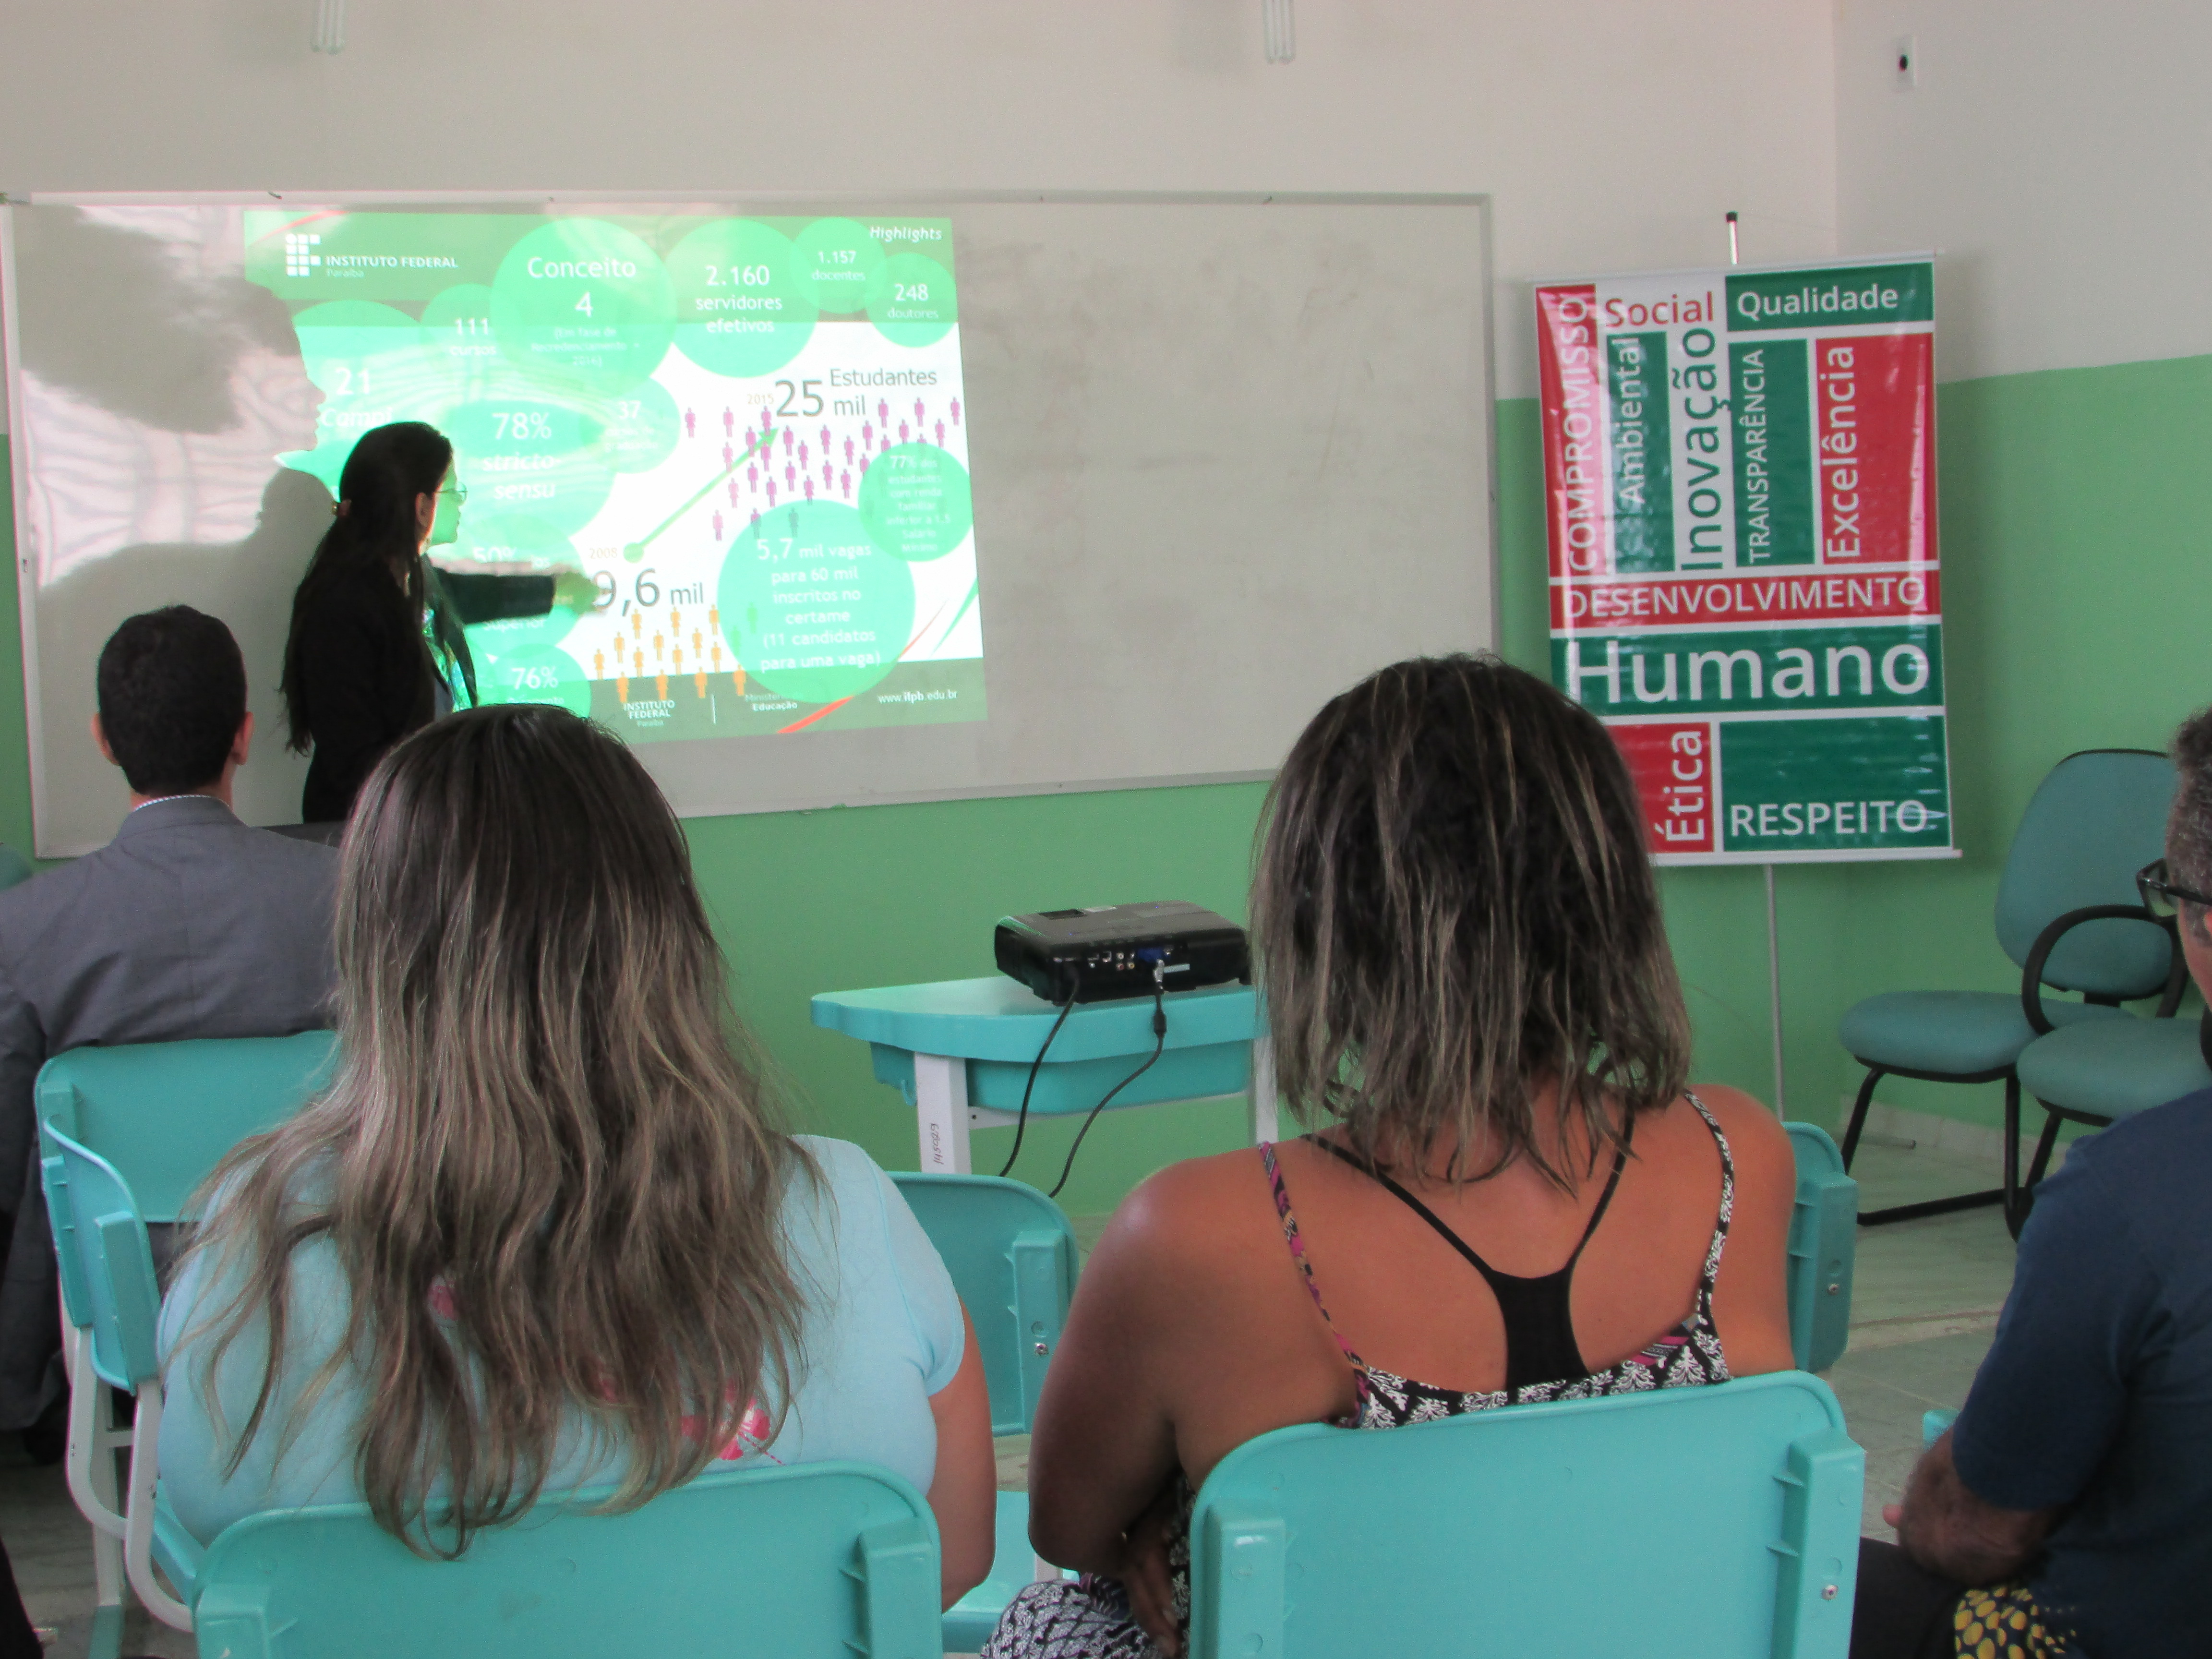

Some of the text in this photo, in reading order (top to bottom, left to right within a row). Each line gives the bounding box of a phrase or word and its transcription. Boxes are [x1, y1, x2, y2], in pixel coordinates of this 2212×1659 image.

[869, 226, 942, 242] Highlights
[326, 255, 459, 268] INSTITUTO FEDERAL
[528, 256, 637, 278] Conceito
[818, 250, 857, 264] 1.157
[705, 265, 770, 287] 2.160
[811, 268, 866, 281] docentes
[696, 294, 782, 311] servidores
[894, 283, 929, 301] 248
[1736, 283, 1899, 319] Qualidade
[575, 291, 593, 318] 4
[888, 308, 939, 319] doutores
[1605, 291, 1714, 328] Social
[454, 317, 489, 336] 111
[706, 317, 775, 333] efetivos
[449, 345, 497, 356] cursos
[335, 367, 371, 396] 21
[775, 367, 938, 417] 25 Estudantes
[617, 399, 642, 420] 37
[747, 393, 774, 405] 2015
[834, 395, 866, 416] mil
[492, 411, 552, 440] 78%
[1611, 337, 1646, 505] Ambiental
[1558, 295, 1598, 572] COMPROMISSO
[1671, 327, 1731, 570] Inovação
[1739, 349, 1771, 564] TRANSPARÊNCIA
[1820, 346, 1861, 559] Excelência
[493, 483, 556, 500] sensu
[589, 547, 618, 560] 2008
[757, 538, 871, 564] 5,7 mil vagas
[771, 565, 859, 587] para 60 mil
[671, 582, 704, 605] mil
[773, 589, 862, 604] inscritos no
[1564, 576, 1926, 618] DESENVOLVIMENTO
[785, 611, 851, 625] certame
[792, 628, 877, 646] candidatos
[760, 649, 881, 674] para uma vaga)
[1565, 639, 1931, 704] Humano
[511, 665, 558, 690] 76%
[624, 699, 675, 711] INSTITUTO
[628, 708, 672, 720] FEDERAL
[752, 700, 798, 711] Educação
[1654, 729, 1705, 842] Ética
[1731, 799, 1928, 837] RESPEITO
